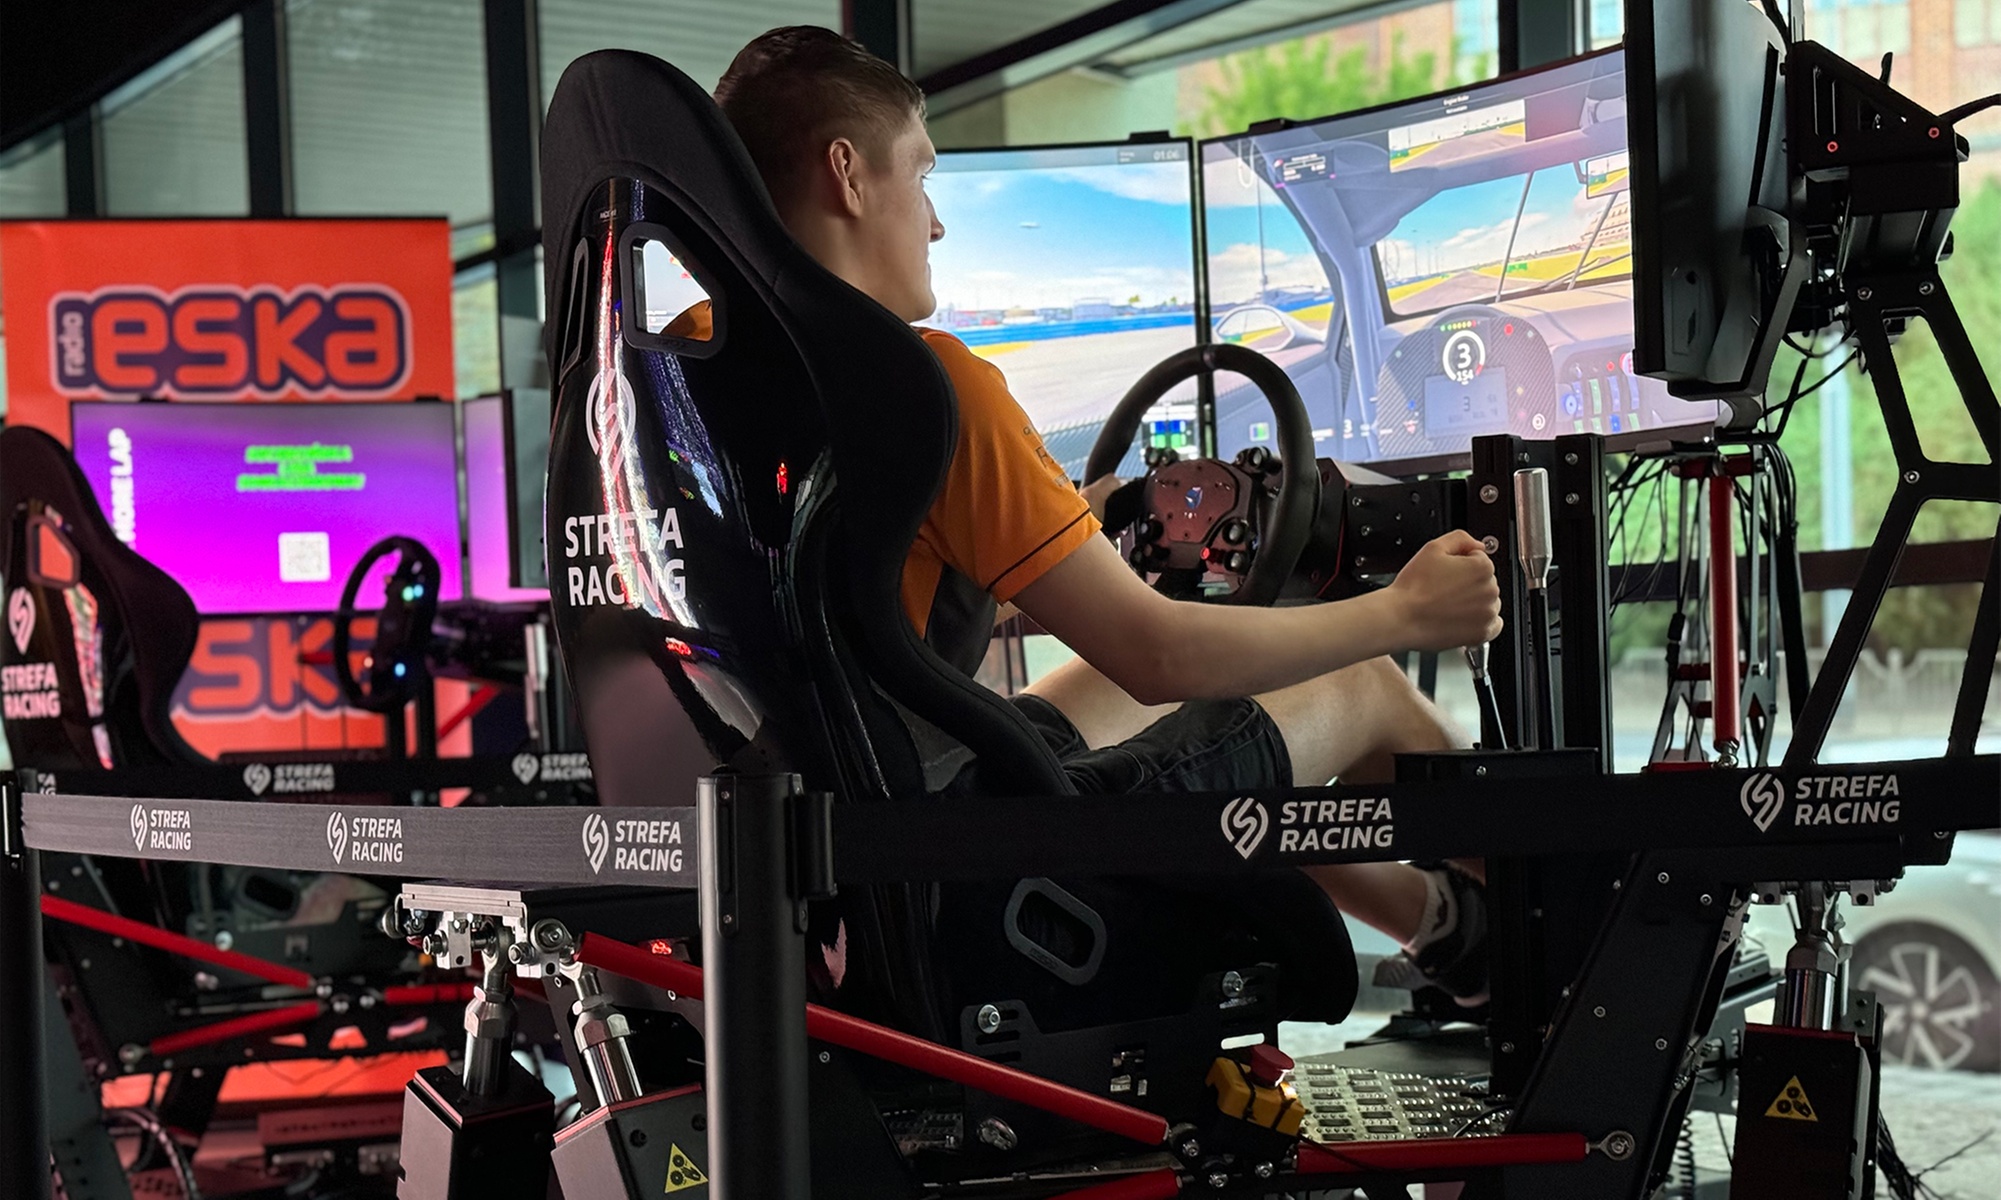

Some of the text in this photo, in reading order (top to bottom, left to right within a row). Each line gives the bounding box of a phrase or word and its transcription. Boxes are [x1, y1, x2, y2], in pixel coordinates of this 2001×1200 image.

[59, 312, 85, 376] radio
[1457, 342, 1472, 369] 3
[108, 428, 133, 476] LAP
[565, 507, 684, 558] STREFA
[1, 662, 59, 693] STREFA
[3, 690, 61, 720] RACING
[273, 764, 334, 779] STREFA
[273, 777, 335, 793] RACING
[1795, 774, 1899, 800] STREFA
[150, 809, 191, 829] STREFA
[1280, 798, 1393, 825] STREFA
[1794, 800, 1900, 826] RACING
[150, 831, 192, 851] RACING
[352, 817, 402, 839] STREFA
[615, 820, 682, 844] STREFA
[1279, 825, 1394, 852] RACING
[352, 841, 403, 863] RACING
[615, 847, 683, 872] RACING
